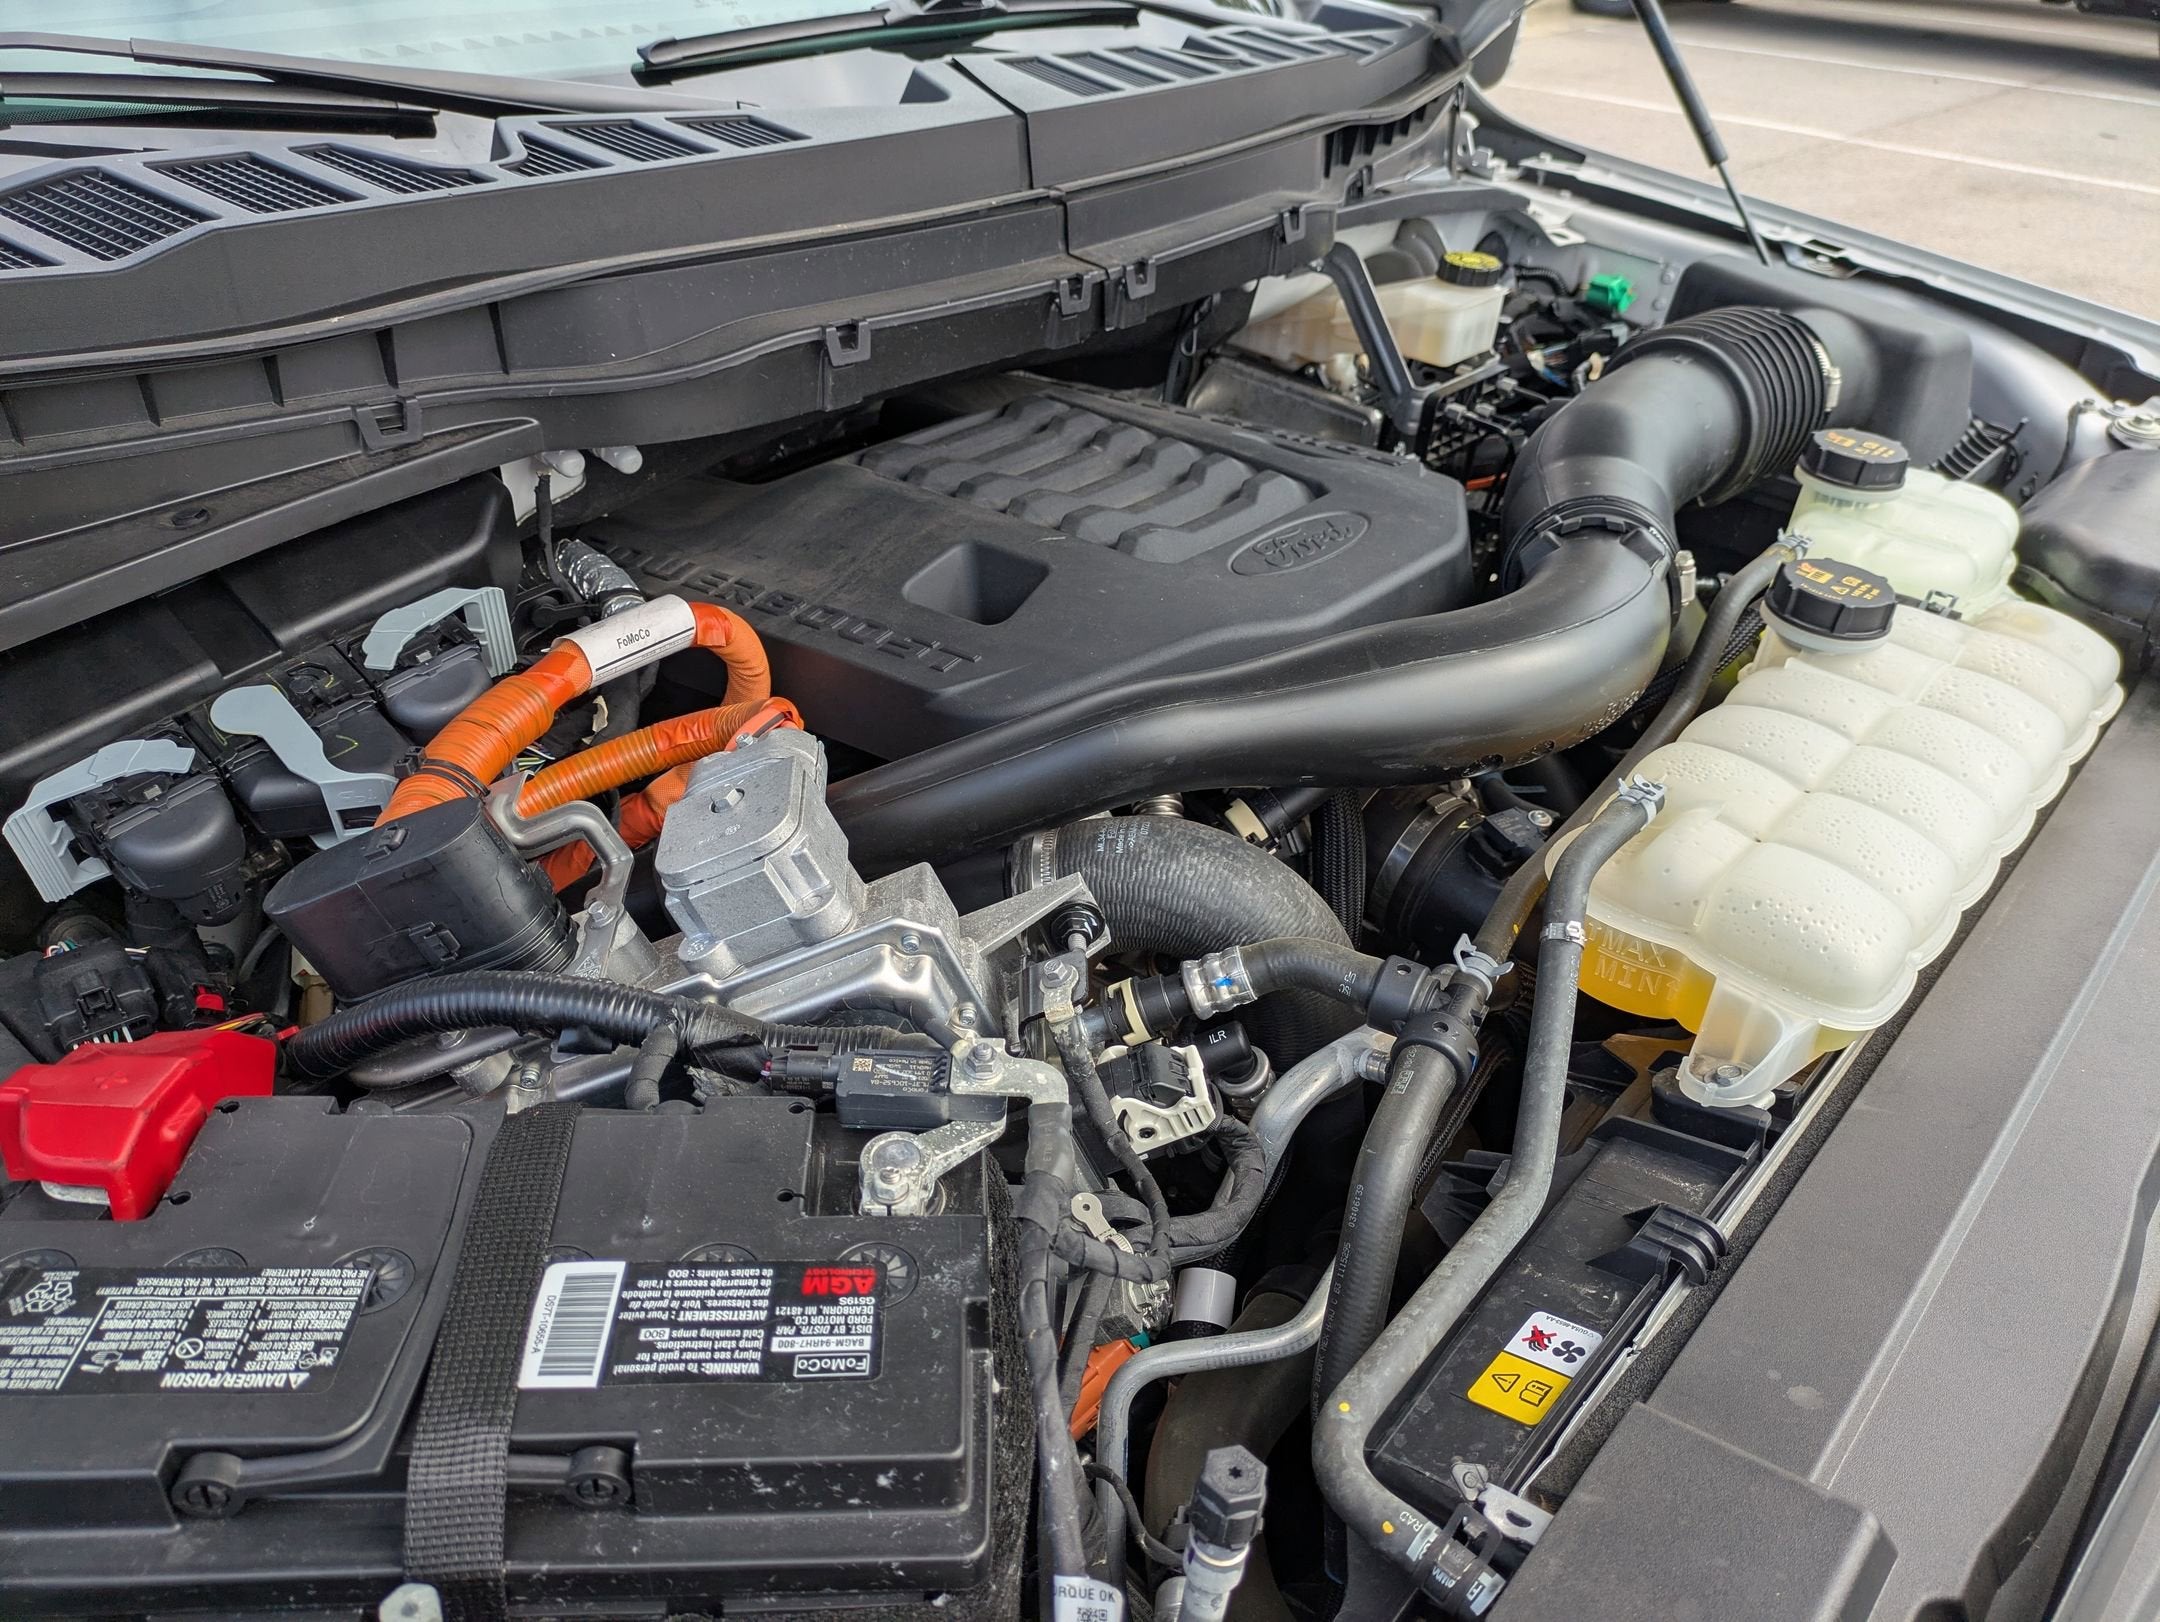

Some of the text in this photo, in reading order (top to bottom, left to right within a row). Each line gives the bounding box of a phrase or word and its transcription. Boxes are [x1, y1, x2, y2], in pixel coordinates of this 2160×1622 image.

[1252, 520, 1353, 568] Ford
[616, 628, 651, 649] FoMoCo
[1602, 929, 1666, 968] MAX
[1594, 955, 1662, 996] MIN
[1348, 1184, 1364, 1228] 03:06:39
[300, 1269, 312, 1277] LA
[312, 1269, 341, 1277] OUVRIR
[341, 1269, 357, 1277] PAS
[357, 1270, 370, 1278] NE
[697, 1270, 729, 1278] volants
[731, 1269, 760, 1278] cables
[762, 1269, 773, 1278] de
[805, 1268, 877, 1276] TECHNOLOGY
[184, 1278, 201, 1286] PAS
[201, 1278, 213, 1286] NE
[250, 1277, 266, 1285] DES
[297, 1278, 308, 1286] LA
[308, 1278, 319, 1286] DE
[320, 1278, 342, 1286] HORS
[637, 1280, 663, 1289] l'aide
[760, 1279, 771, 1288] de
[264, 1286, 276, 1295] OF
[276, 1286, 301, 1295] REACH
[801, 1276, 875, 1296] AGM
[154, 1287, 170, 1295] NOT
[170, 1287, 183, 1295] DO
[302, 1287, 315, 1295] THE
[315, 1287, 327, 1295] OF
[327, 1287, 343, 1295] OUT
[662, 1290, 672, 1299] la
[717, 1288, 770, 1298] proprietaire
[247, 1301, 257, 1309] DE
[629, 1299, 769, 1310] des blessures. Voir le guide du
[838, 1297, 876, 1305] G519S
[239, 1310, 252, 1319] LES
[298, 1310, 337, 1319] EXPLOSIFS
[338, 1310, 352, 1319] GAZ
[775, 1305, 874, 1315] DEARBORN, MI 48121
[647, 1311, 669, 1319] Pour
[677, 1310, 767, 1320] AVERTISSEMENT
[792, 1315, 873, 1324] FORD MOTOR CO.
[256, 1320, 272, 1329] LES
[272, 1320, 293, 1329] YEUX
[293, 1320, 308, 1329] LES
[202, 1329, 216, 1338] LES
[644, 1327, 764, 1339] Cold cranking amps 800
[776, 1325, 872, 1335] DIST. BY DISTR. PAR
[654, 1339, 763, 1350] jump start instructions.
[635, 1353, 651, 1362] for
[653, 1350, 680, 1361] guide
[713, 1351, 732, 1359] see
[733, 1350, 761, 1361] injury
[244, 1361, 267, 1371] EYES
[613, 1363, 760, 1375] WARNING: To avoid personal
[798, 1358, 867, 1372] FoMoCo
[160, 1372, 287, 1388] DANGER/POISON
[1400, 1511, 1423, 1532] RAD
[1055, 1586, 1116, 1602] RQUE OK
